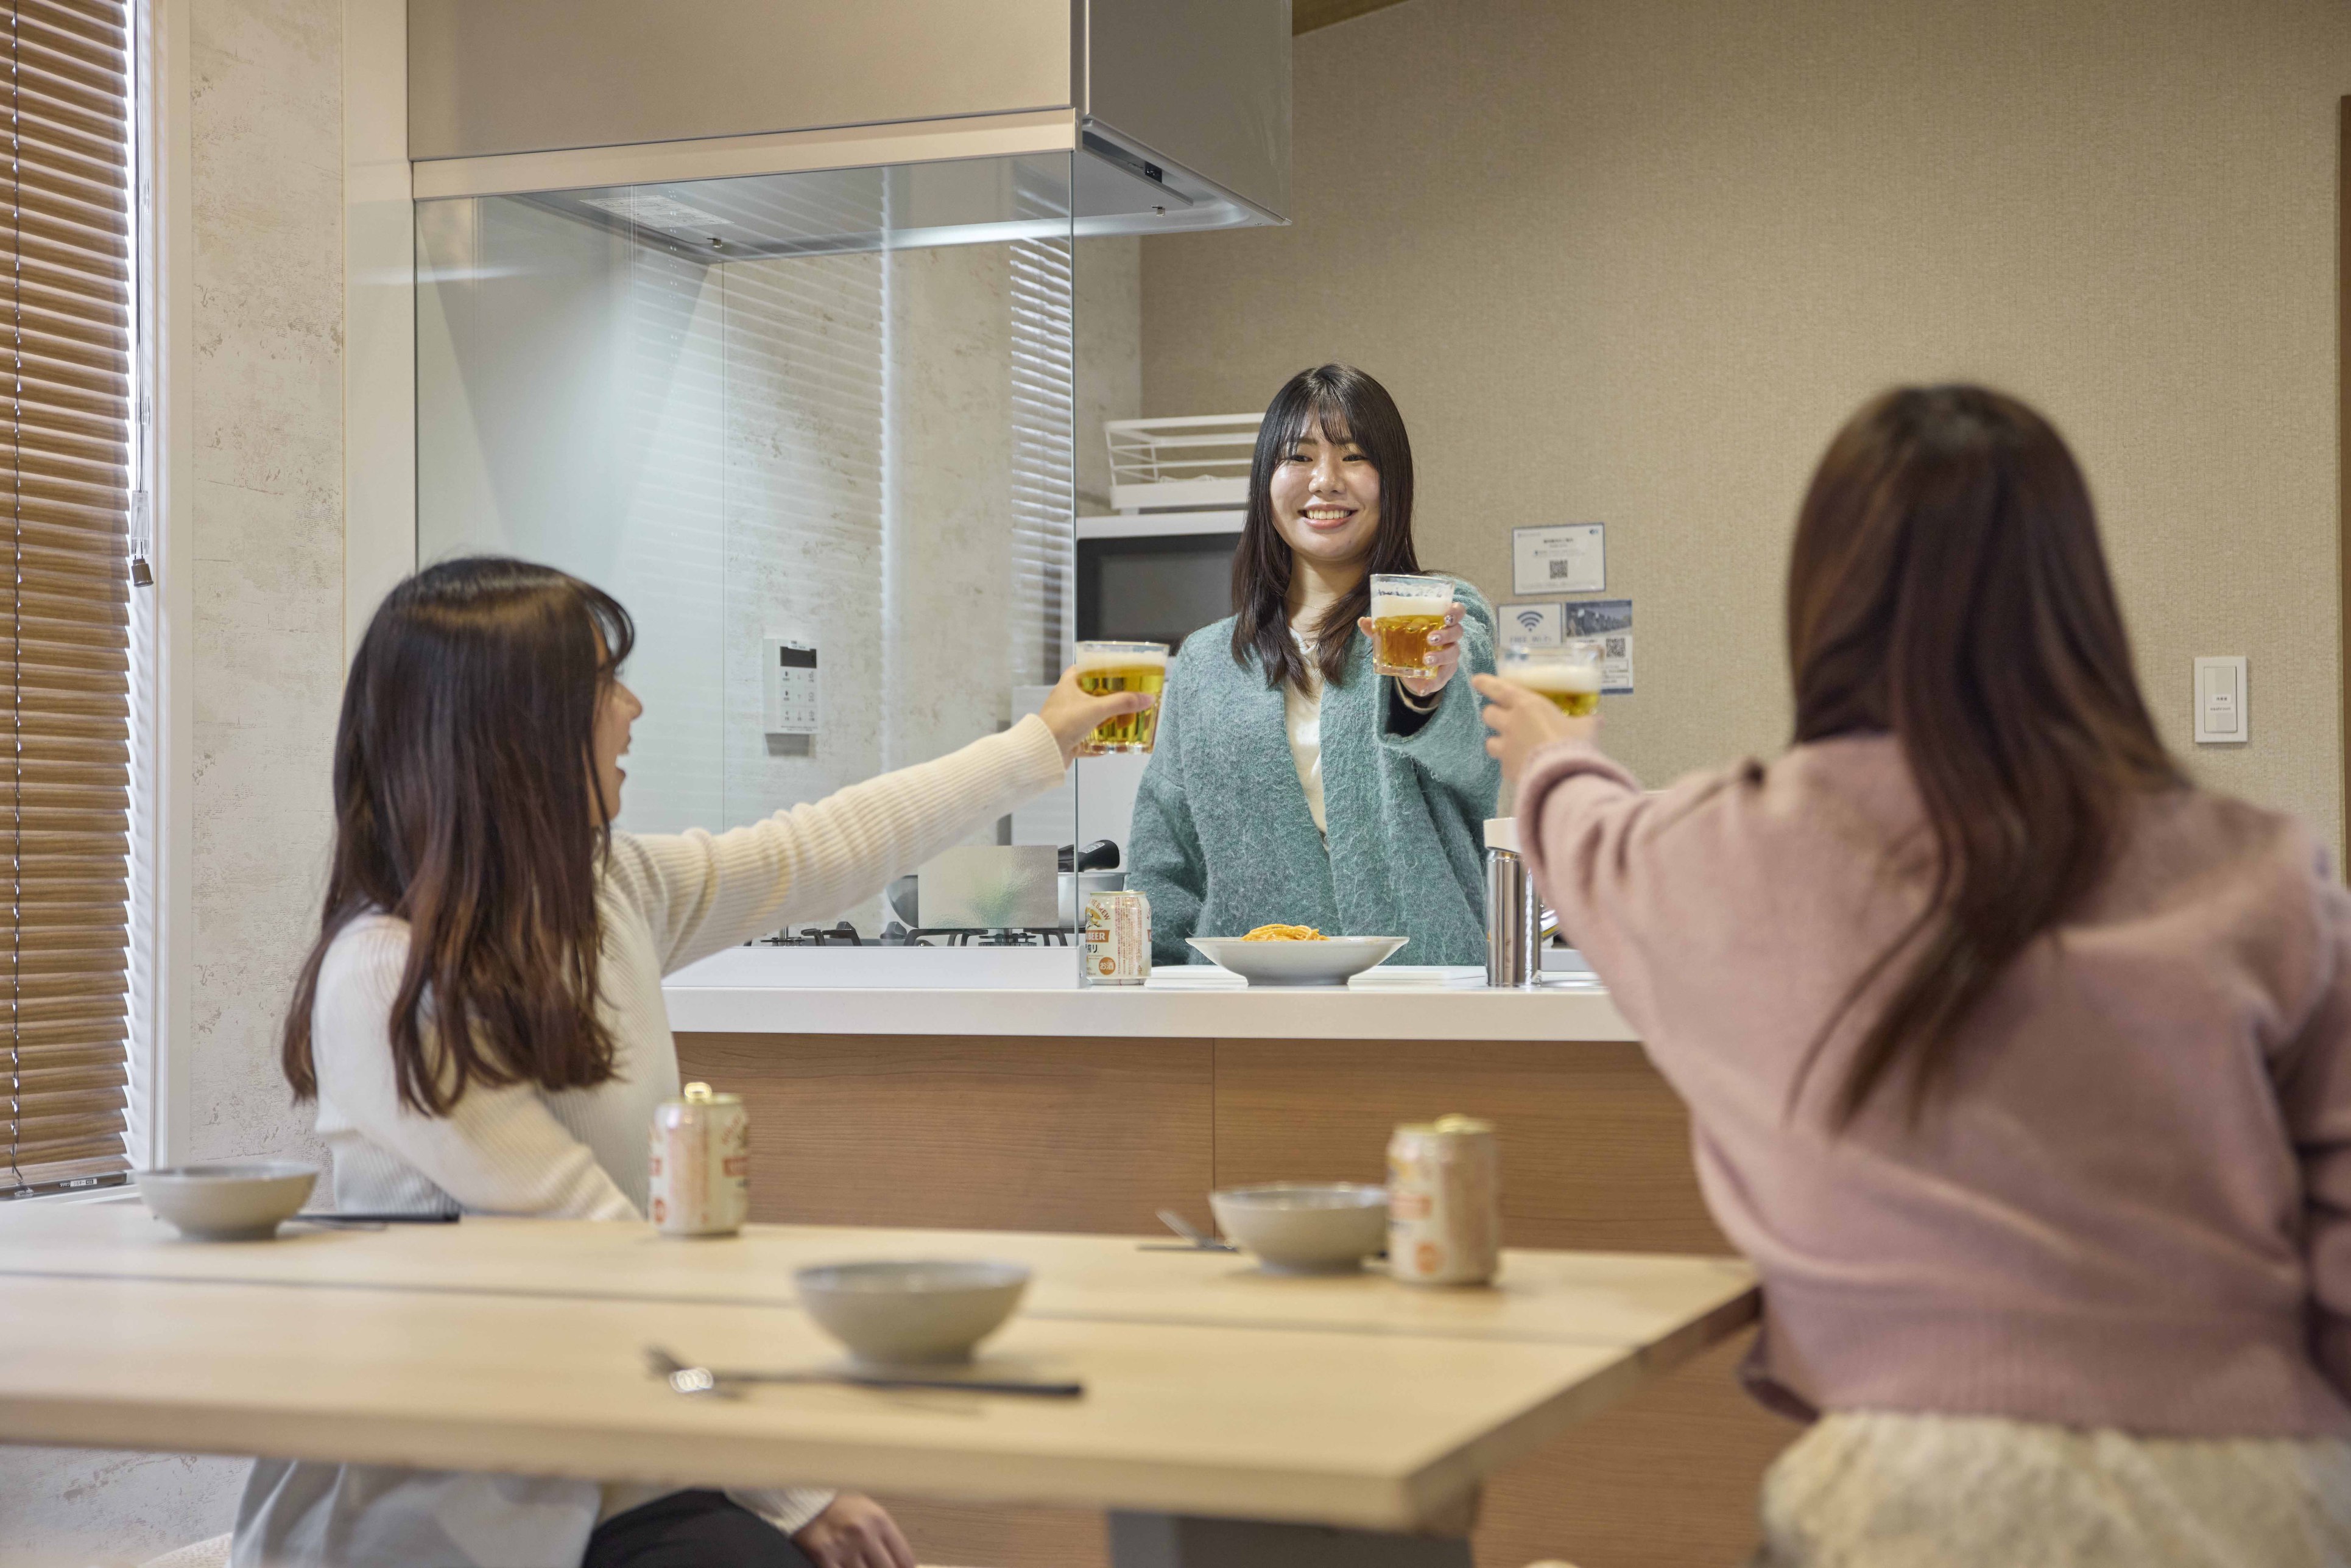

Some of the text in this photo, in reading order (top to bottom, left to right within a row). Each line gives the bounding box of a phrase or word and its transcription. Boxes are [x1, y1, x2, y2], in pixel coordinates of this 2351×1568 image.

[1096, 902, 1111, 920] BREW
[1088, 932, 1105, 941] BEER
[1086, 944, 1098, 954] 搾り
[1099, 962, 1114, 971] お酒
